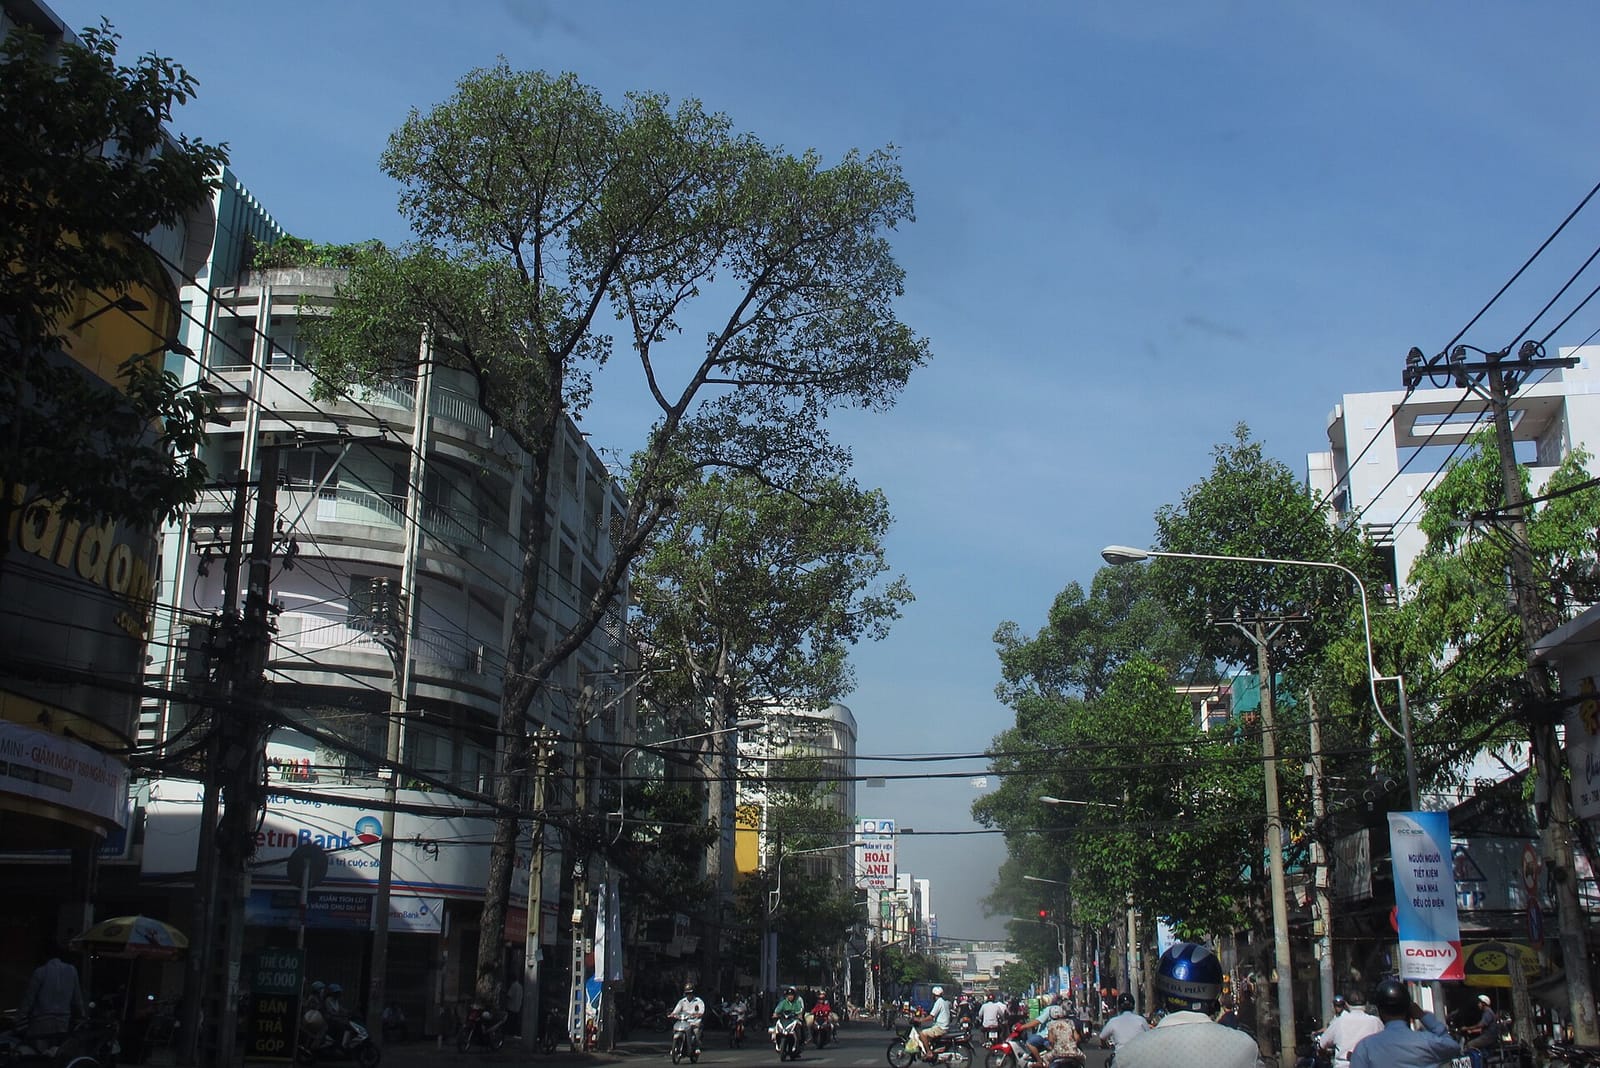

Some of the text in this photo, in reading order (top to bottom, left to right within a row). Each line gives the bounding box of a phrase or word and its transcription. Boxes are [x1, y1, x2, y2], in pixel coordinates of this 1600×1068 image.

[865, 850, 890, 862] HOÀI
[866, 864, 888, 874] ANH
[1406, 948, 1451, 958] CADIVI
[257, 972, 296, 986] 95.000
[259, 998, 288, 1014] BÁN
